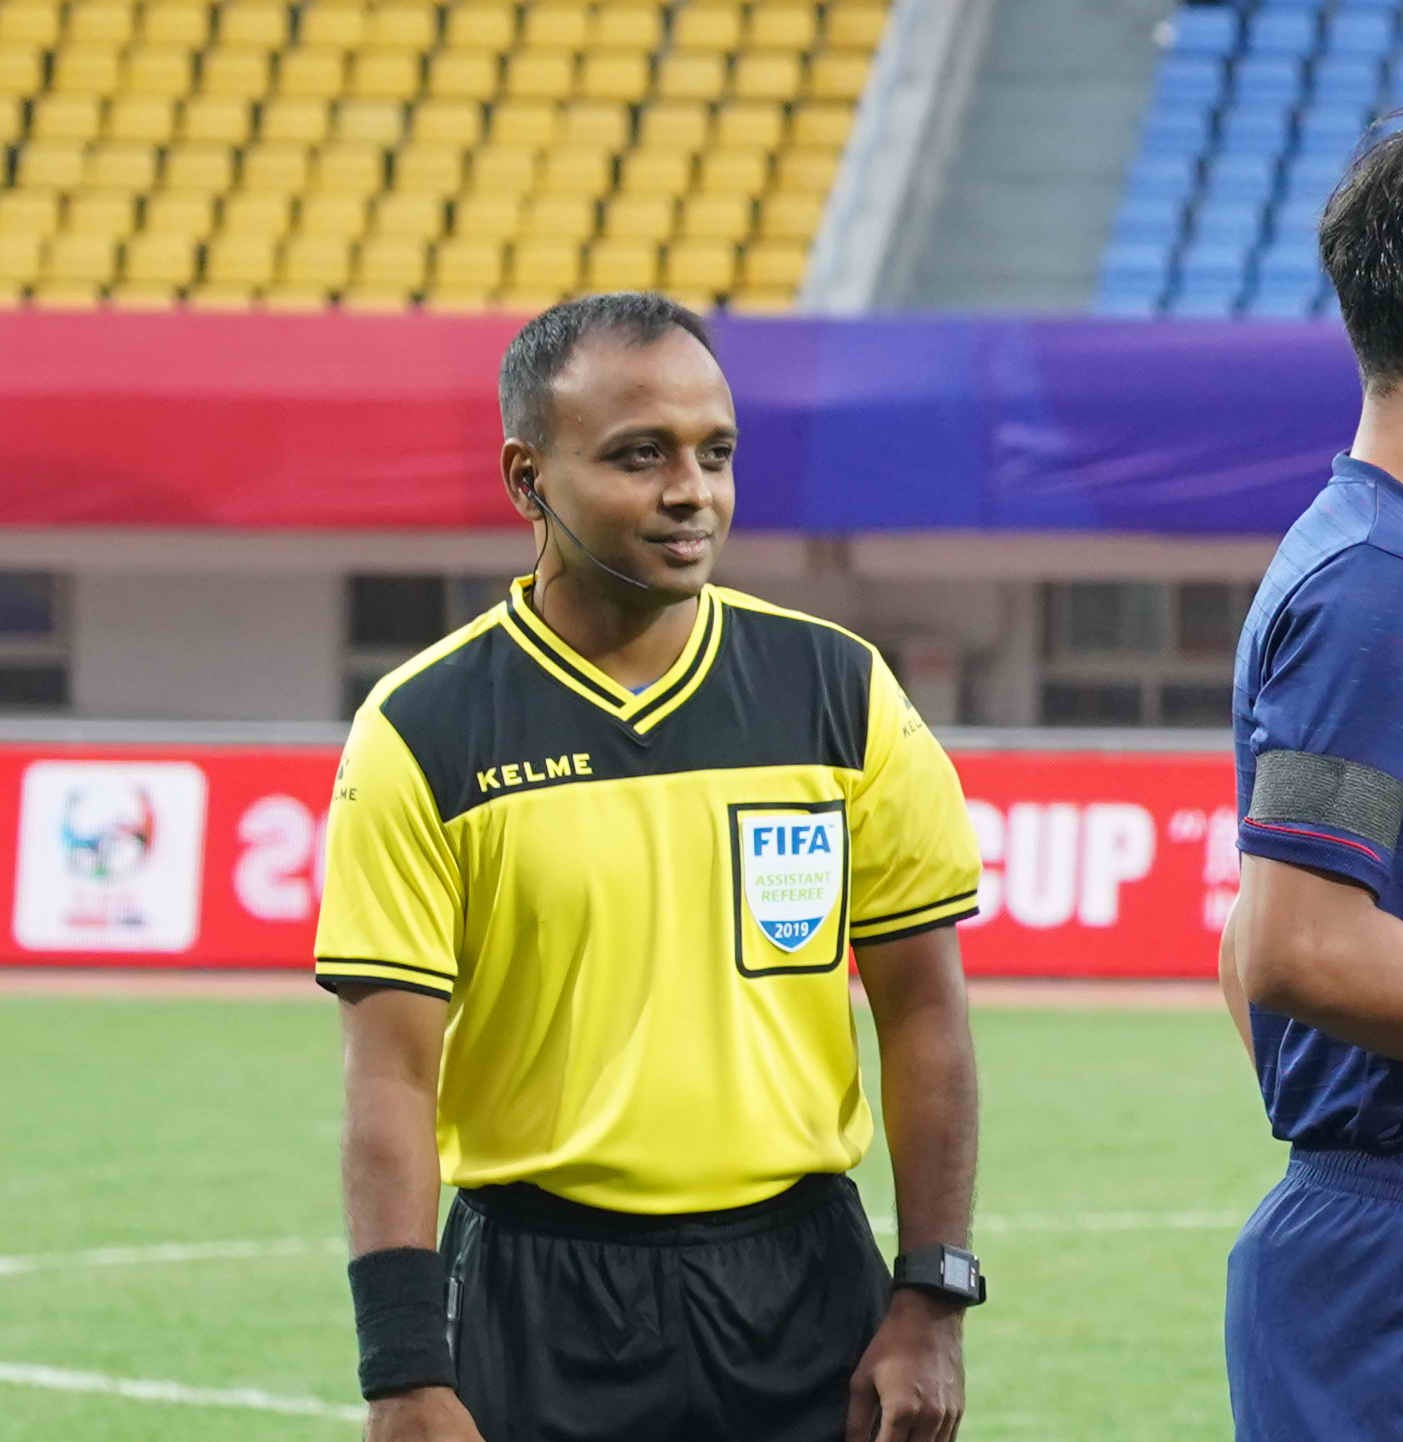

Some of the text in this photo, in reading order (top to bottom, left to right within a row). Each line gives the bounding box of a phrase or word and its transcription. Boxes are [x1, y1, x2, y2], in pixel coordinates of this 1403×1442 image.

[476, 753, 592, 792] KELME
[753, 825, 831, 856] FIFA
[755, 872, 831, 886] ASSISTANT
[761, 886, 824, 902] REFEREE
[774, 921, 809, 939] 2019
